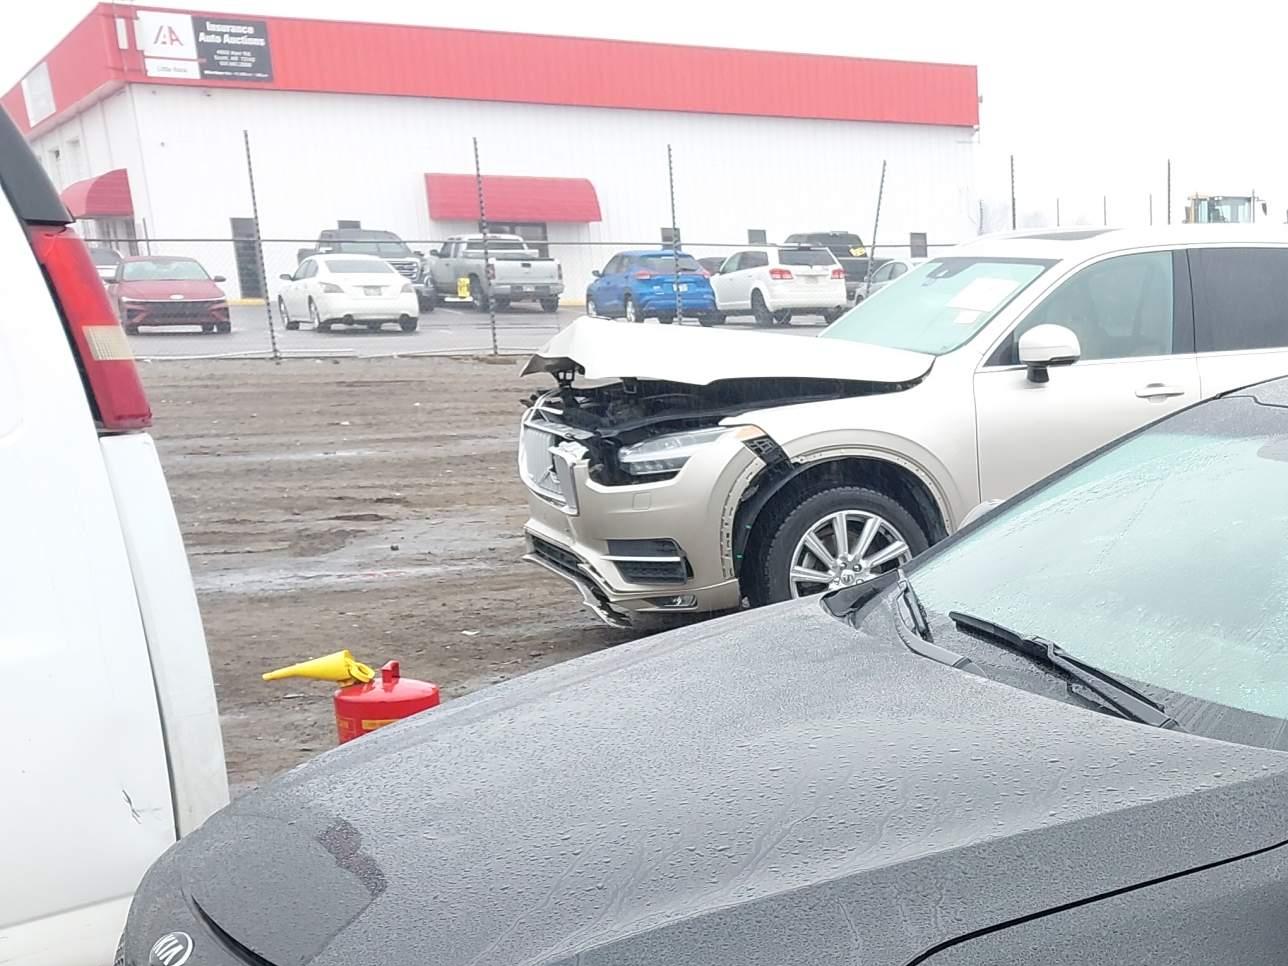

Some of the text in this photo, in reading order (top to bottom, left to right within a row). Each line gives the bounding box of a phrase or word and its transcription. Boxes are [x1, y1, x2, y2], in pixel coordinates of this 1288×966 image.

[206, 21, 255, 34] Insurance
[198, 32, 266, 46] Auto Auctions
